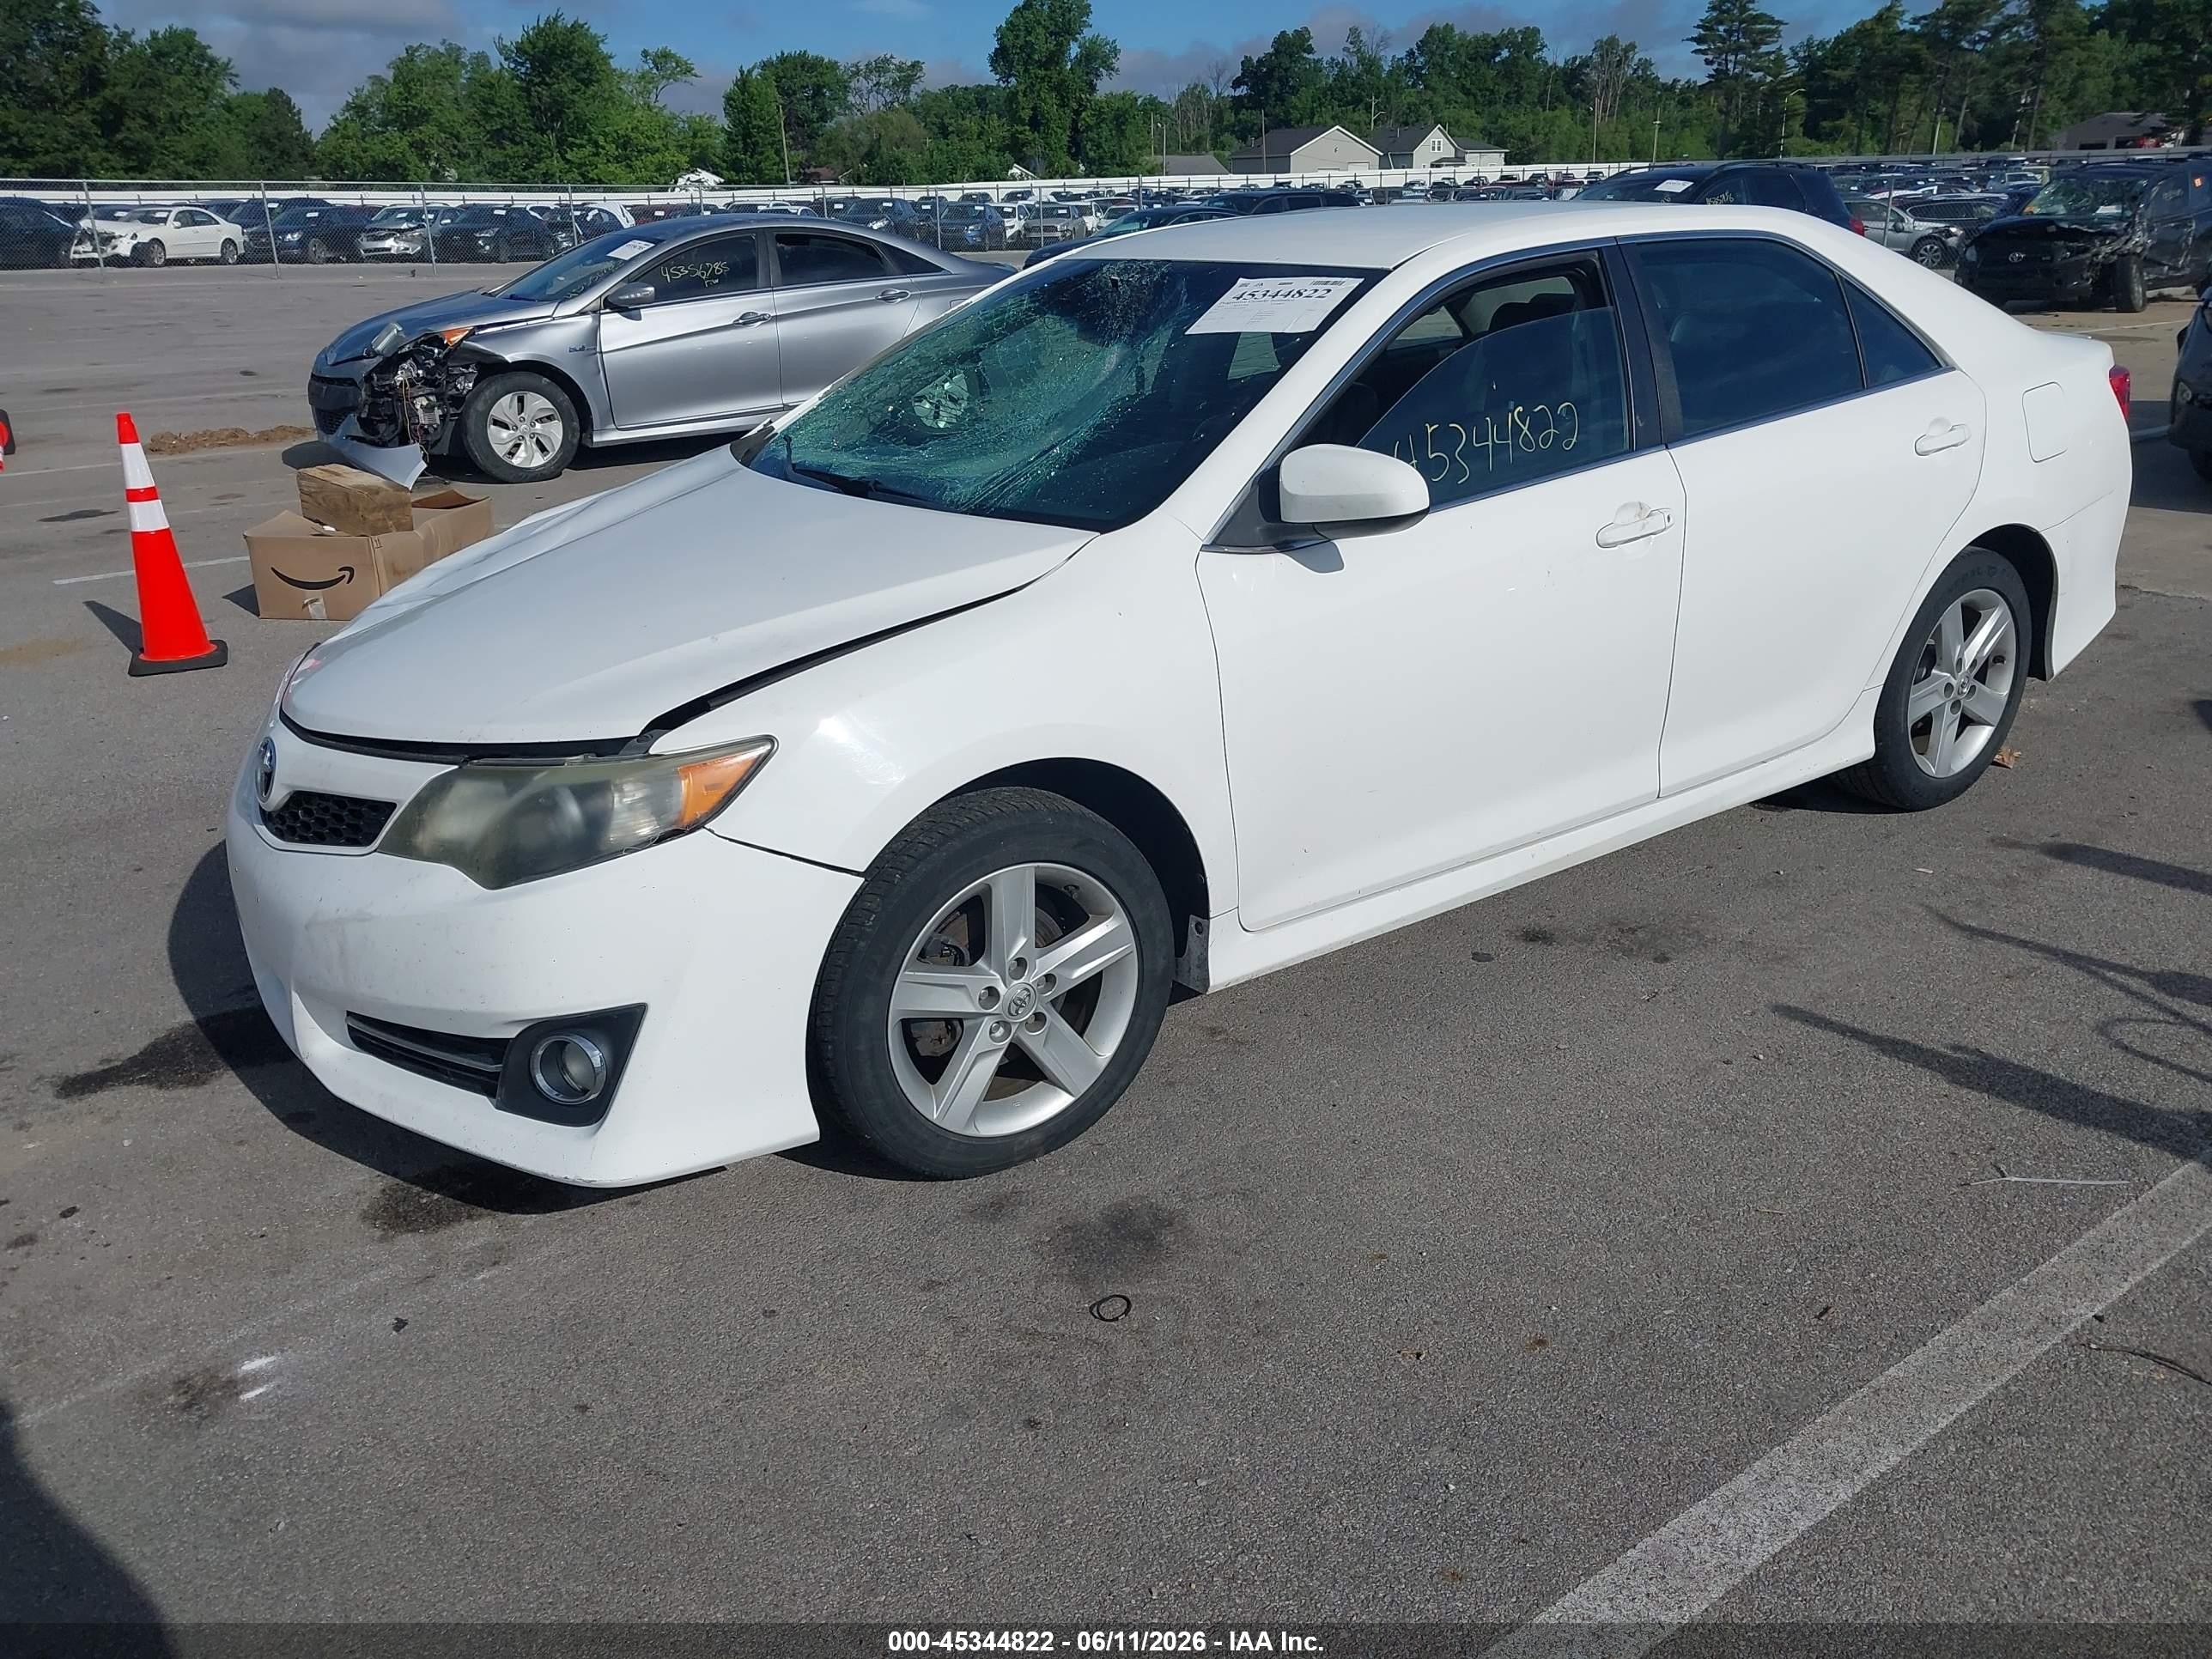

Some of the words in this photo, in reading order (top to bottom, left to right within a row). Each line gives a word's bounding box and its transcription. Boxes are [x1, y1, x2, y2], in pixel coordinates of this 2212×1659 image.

[660, 261, 730, 283] 45356785
[1231, 288, 1334, 301] 45344822
[1394, 401, 1579, 484] 45344822
